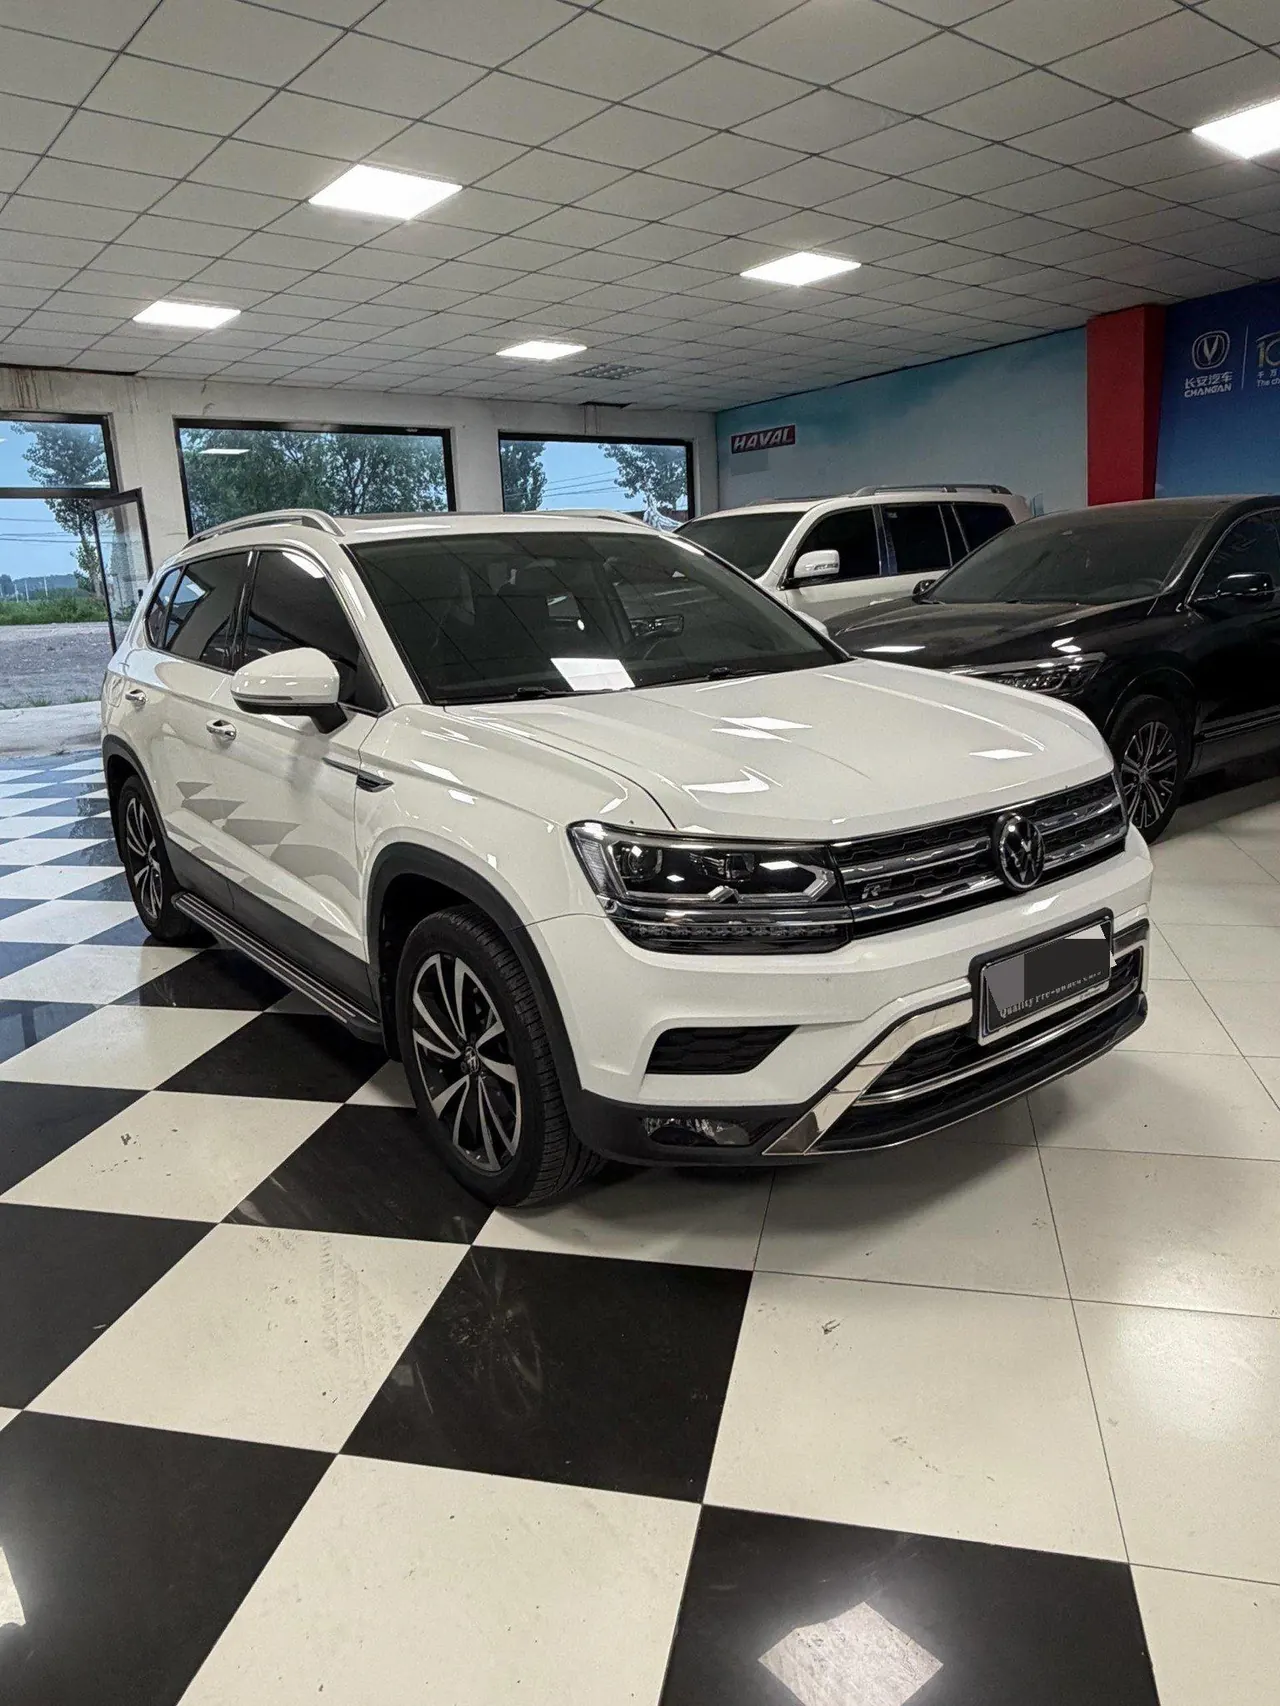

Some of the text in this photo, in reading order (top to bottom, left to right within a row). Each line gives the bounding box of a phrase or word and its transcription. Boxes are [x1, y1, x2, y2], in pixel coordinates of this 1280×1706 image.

[1184, 382, 1232, 398] CHANGAN
[1185, 372, 1233, 389] 长安汽车
[733, 428, 793, 451] HAVAL
[998, 996, 1035, 1019] Quality
